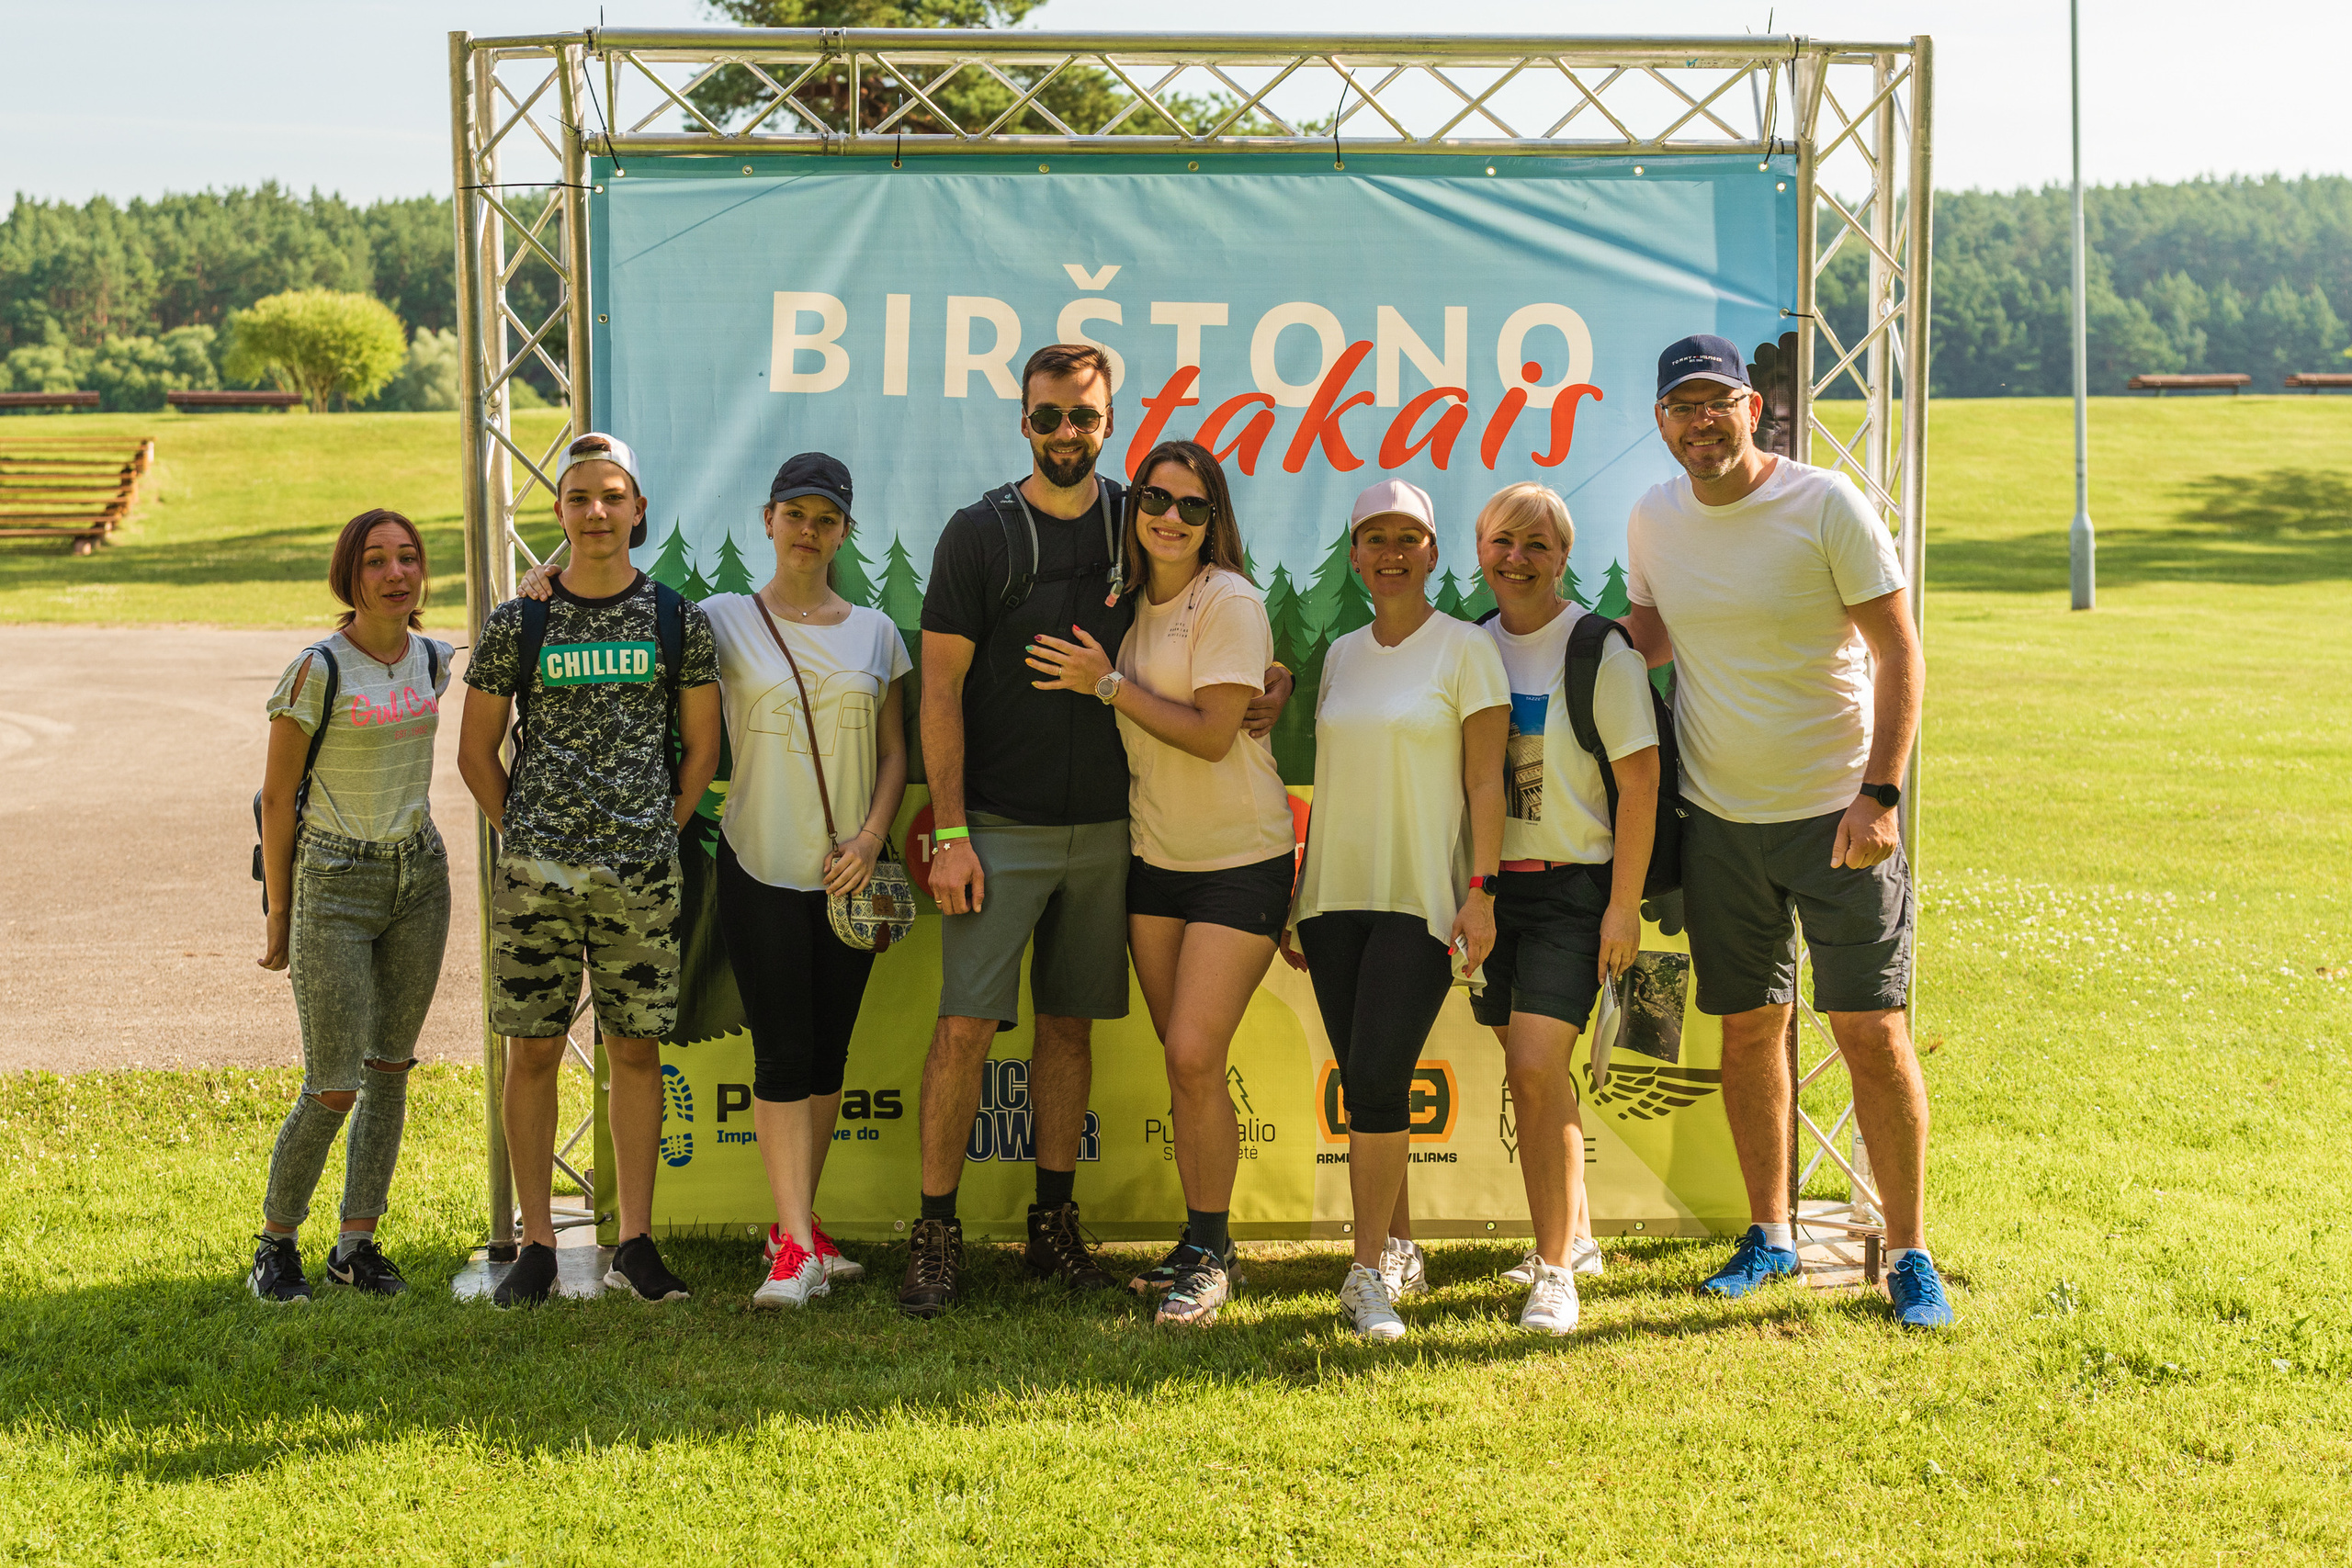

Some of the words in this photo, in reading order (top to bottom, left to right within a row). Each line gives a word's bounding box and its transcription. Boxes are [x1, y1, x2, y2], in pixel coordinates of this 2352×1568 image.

[770, 263, 1594, 410] BIRŠTONO
[1125, 340, 1604, 483] takais
[547, 649, 649, 679] CHILLED
[351, 690, 403, 727] Girl
[856, 1126, 880, 1141] do
